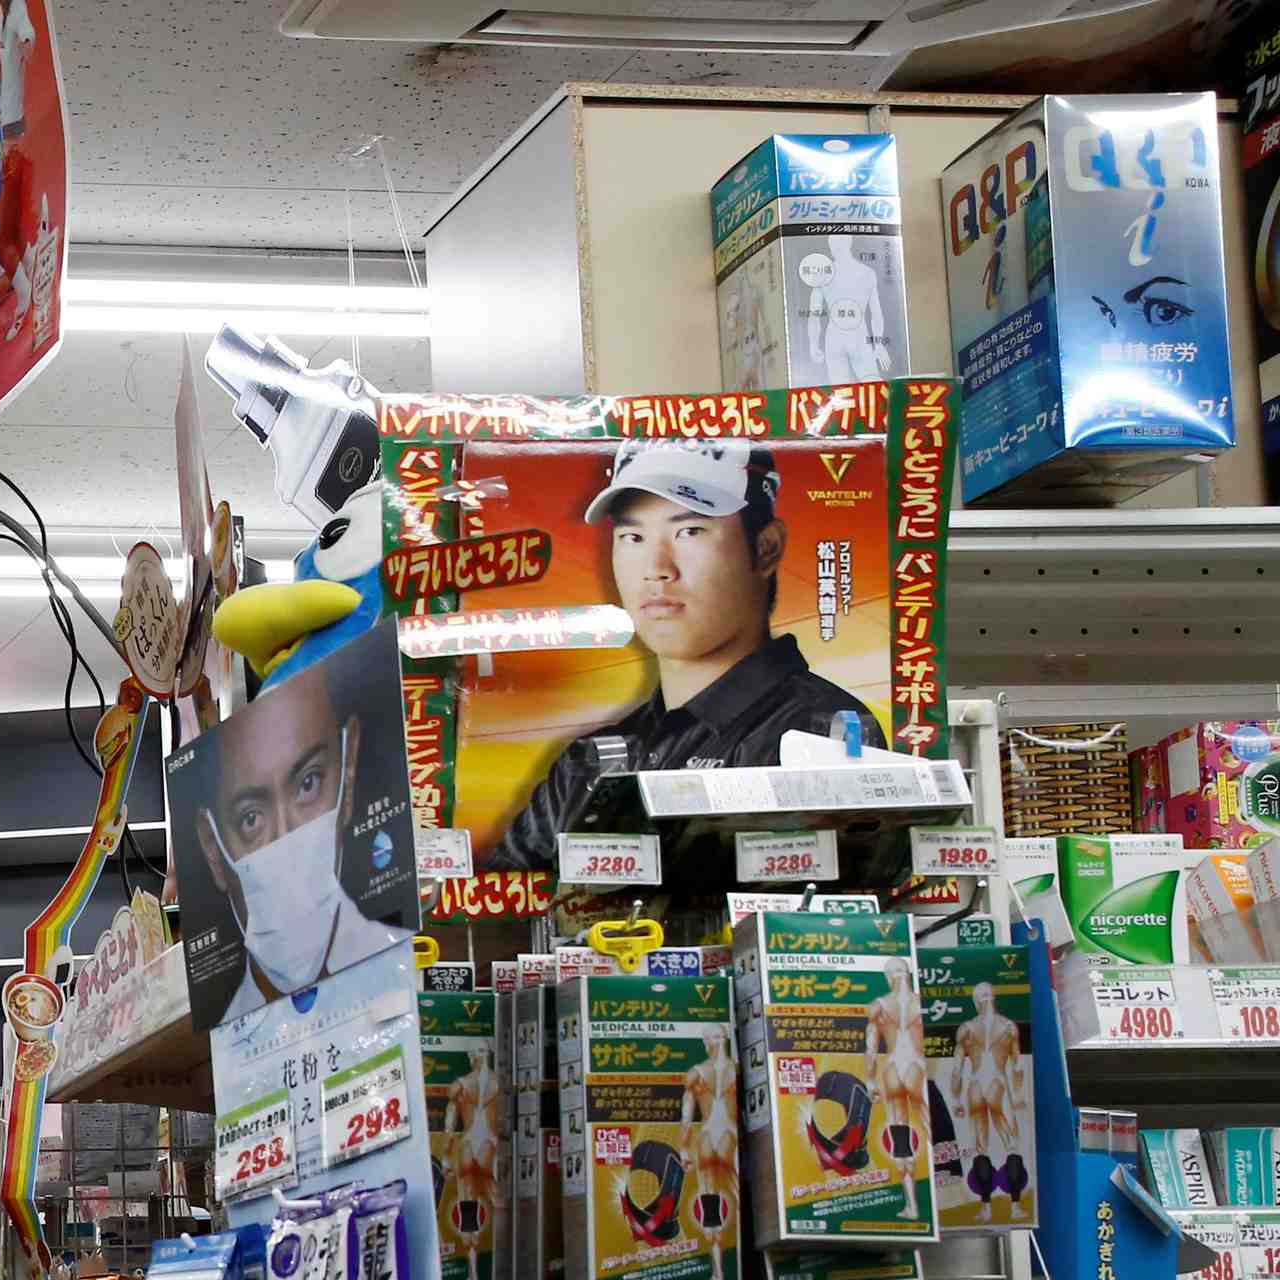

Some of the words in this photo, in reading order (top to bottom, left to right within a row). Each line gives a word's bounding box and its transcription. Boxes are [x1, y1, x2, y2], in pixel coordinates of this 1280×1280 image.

[950, 140, 1039, 257] Q&P
[611, 396, 769, 438] ツラいところに
[899, 382, 948, 540] ツラいところに
[807, 490, 873, 501] VANTELIN
[385, 533, 545, 597] ツラいところに
[1089, 911, 1168, 928] nicorette
[768, 955, 823, 966] MEDICAL
[826, 955, 856, 966] IDEA
[771, 977, 868, 999] サポーター
[1094, 986, 1170, 1001] ニコレット
[591, 1023, 648, 1034] MEDICAL
[651, 1022, 676, 1033] IDEA
[1120, 1006, 1174, 1040] 4980
